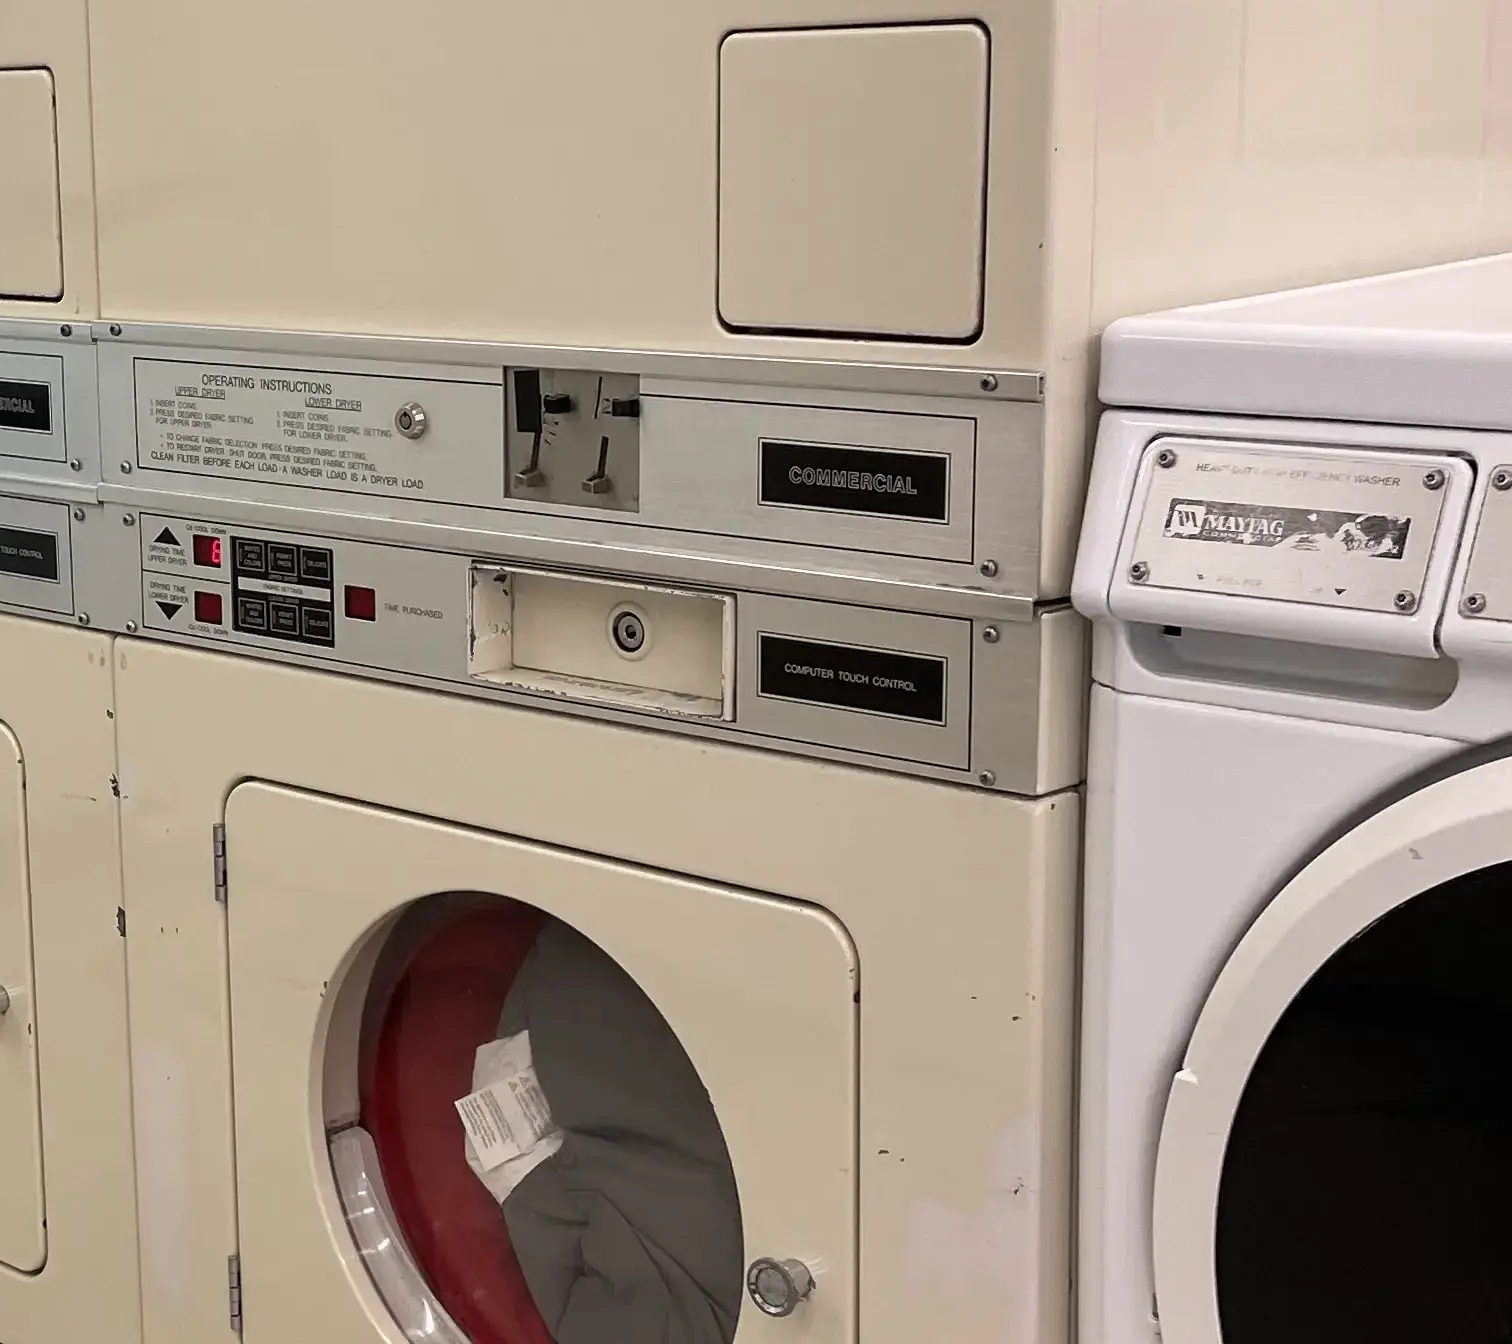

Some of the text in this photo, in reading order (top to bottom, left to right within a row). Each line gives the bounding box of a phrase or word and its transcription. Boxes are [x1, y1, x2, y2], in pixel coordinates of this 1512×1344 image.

[202, 374, 332, 395] OPERATING INSTRUCTIONS
[175, 386, 225, 397] UPPER DRYER
[305, 397, 362, 409] LOWER DRYER
[283, 411, 305, 420] INSERT
[155, 417, 168, 425] FOR
[170, 418, 189, 427] UPPER
[307, 423, 335, 432] DESIRED
[338, 425, 360, 435] FABRIC
[299, 431, 321, 440] LOWER
[270, 453, 290, 462] PRESS
[294, 456, 320, 466] DESIRED
[323, 459, 345, 469] FABRIC
[151, 450, 174, 461] CLEAN
[177, 454, 200, 464] FILTER
[203, 457, 231, 468] BEFORE
[234, 460, 254, 470] EACH
[258, 463, 278, 473] LOAD
[291, 467, 323, 478] WASHER
[326, 471, 347, 480] LOAD
[351, 473, 358, 482] IS
[361, 475, 367, 483] A
[371, 475, 398, 486] DRYER
[788, 465, 918, 495] COMMERCIAL
[1204, 514, 1285, 536] MAYTAG
[0, 545, 18, 555] TOUCH
[19, 548, 43, 560] CONTROL
[172, 547, 185, 556] TIME
[148, 555, 166, 563] UPPER
[173, 585, 186, 594] TIME
[384, 603, 443, 620] TIME PURCHASED
[784, 663, 917, 692] COMPUTER TOUCH CONTROL
